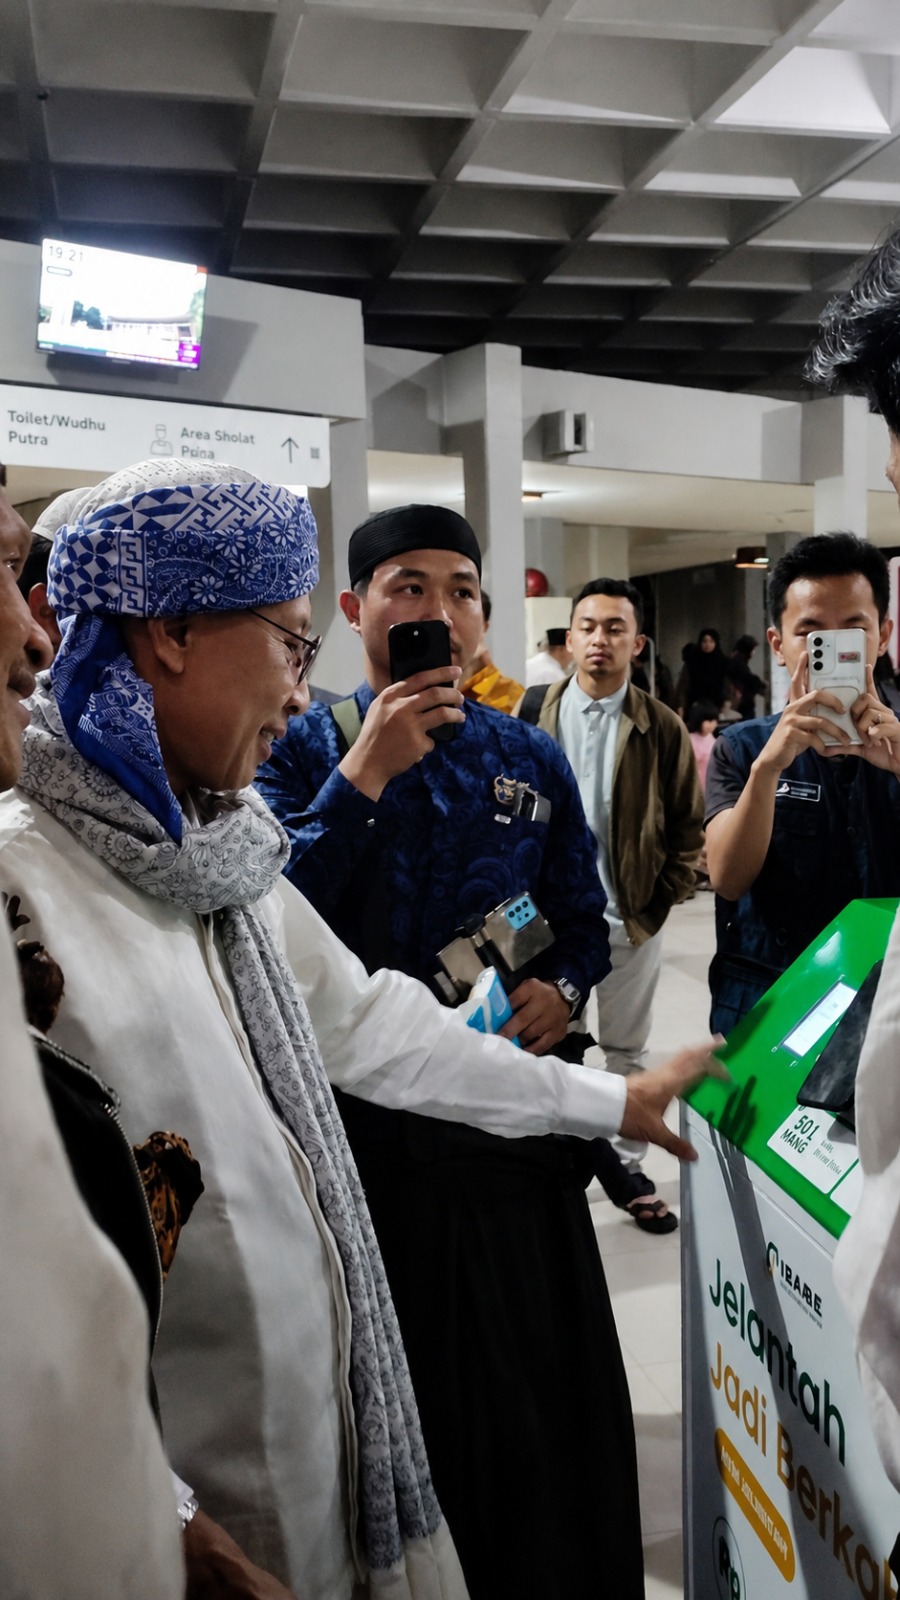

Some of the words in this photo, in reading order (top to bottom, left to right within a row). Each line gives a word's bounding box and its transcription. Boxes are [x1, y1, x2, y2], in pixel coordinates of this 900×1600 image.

[8, 409, 106, 431] Toilet/Wudhu
[9, 430, 48, 446] Putra
[181, 427, 211, 440] Area
[215, 430, 255, 444] Sholat
[709, 1258, 845, 1467] Jelantah
[711, 1341, 767, 1457] Jadi
